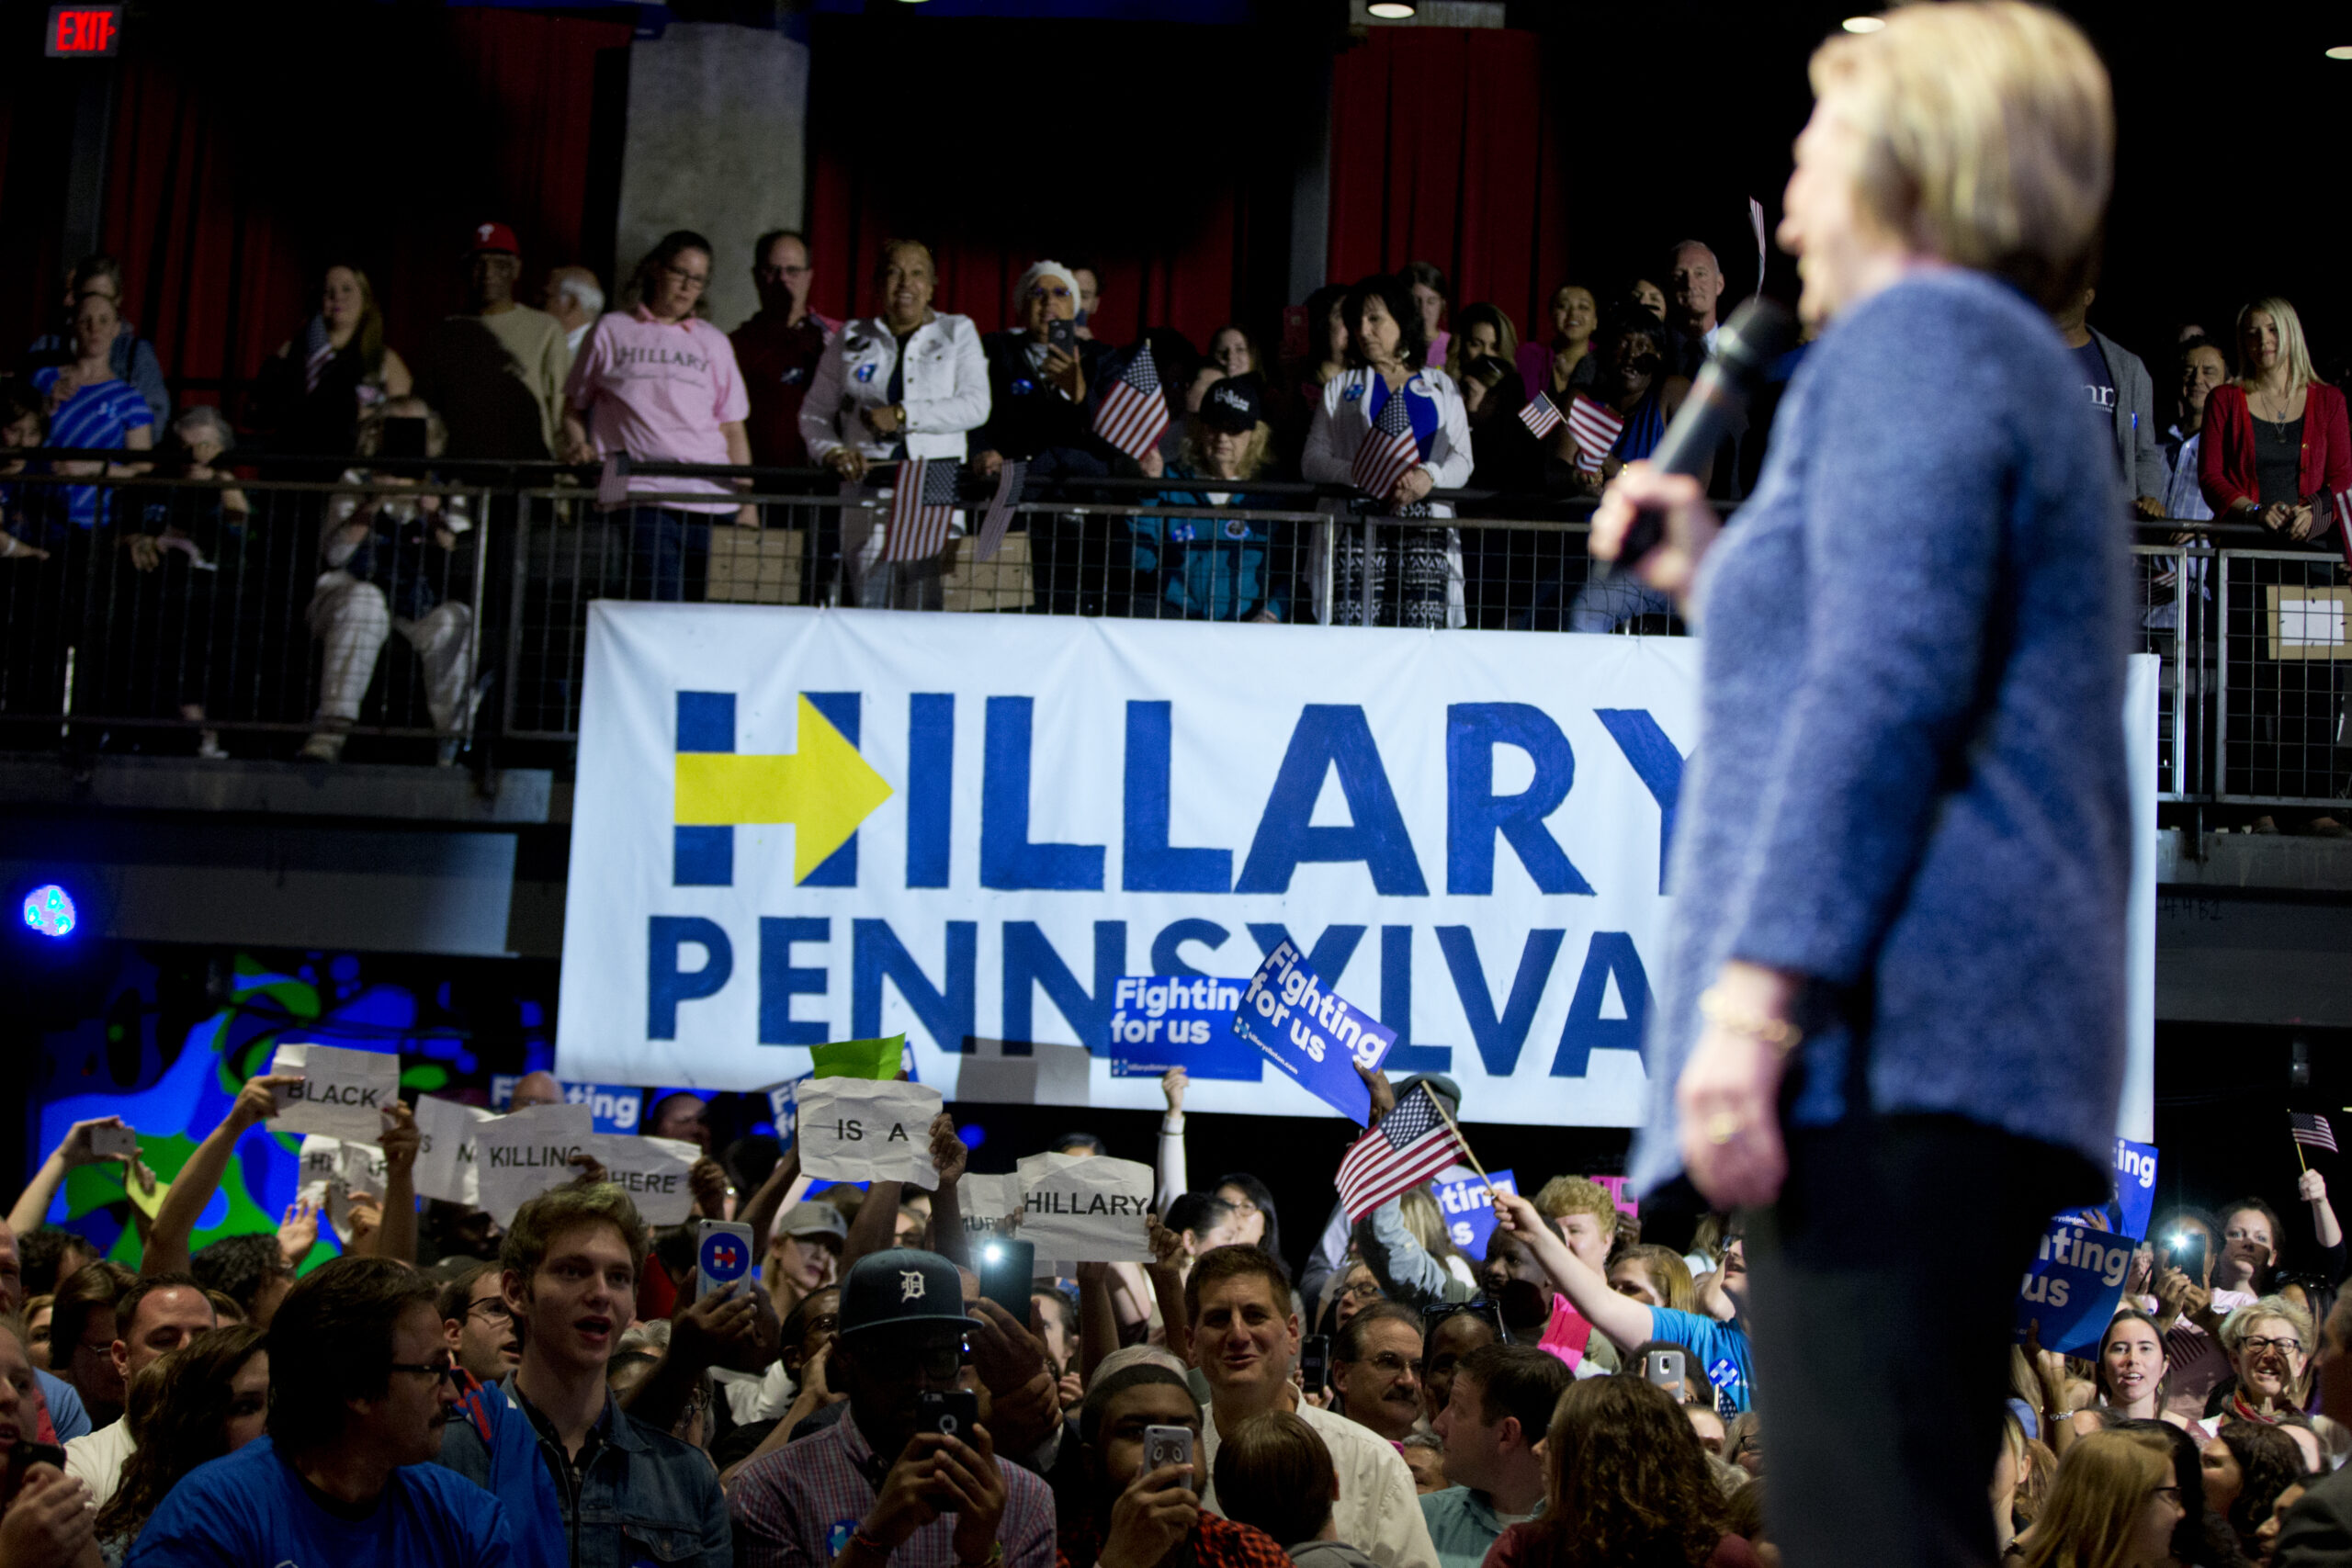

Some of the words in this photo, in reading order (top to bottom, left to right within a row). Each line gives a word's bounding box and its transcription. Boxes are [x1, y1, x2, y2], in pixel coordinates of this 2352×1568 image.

[56, 11, 114, 51] EXIT
[618, 345, 709, 372] HILLARY
[2081, 384, 2115, 407] nn
[1114, 976, 1245, 1018] Fightin
[1265, 941, 1387, 1069] Fighting
[1110, 1011, 1163, 1043] for
[1168, 1020, 1211, 1044] us
[1245, 972, 1290, 1028] for
[1290, 1017, 1327, 1063] us
[288, 1080, 379, 1109] BLACK
[492, 1076, 639, 1128] Fting
[838, 1119, 863, 1141] IS
[888, 1122, 909, 1142] A
[490, 1145, 582, 1168] KILLING
[611, 1172, 677, 1193] HERE
[1023, 1191, 1148, 1216] HILLARY
[899, 1269, 925, 1303] D
[2022, 1273, 2071, 1308] us
